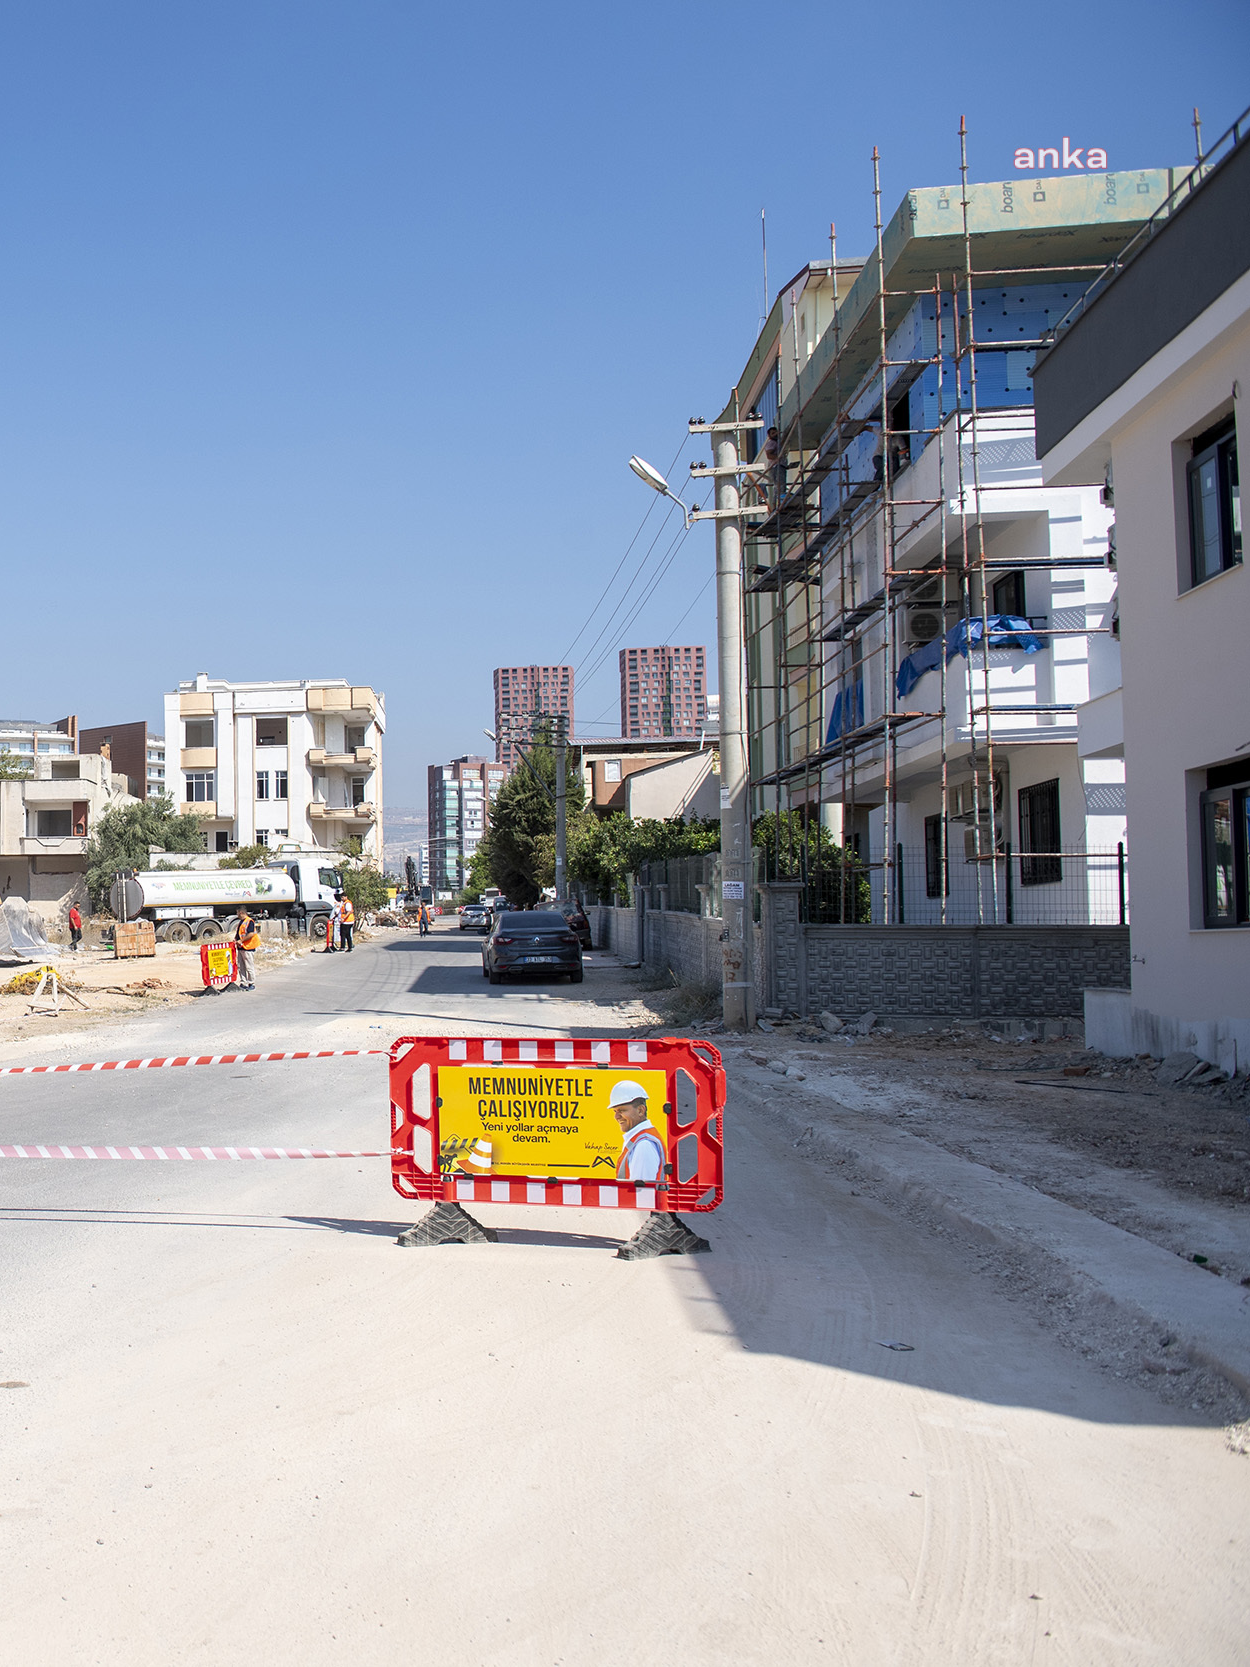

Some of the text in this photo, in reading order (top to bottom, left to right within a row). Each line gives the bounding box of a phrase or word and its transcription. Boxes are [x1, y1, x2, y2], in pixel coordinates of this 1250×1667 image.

[468, 1074, 593, 1097] MEMNUNİYETLE
[478, 1099, 585, 1121] ÇALIŞIYORUZ.
[482, 1122, 579, 1135] Yeni yollar açmaya
[512, 1133, 551, 1144] devam.
